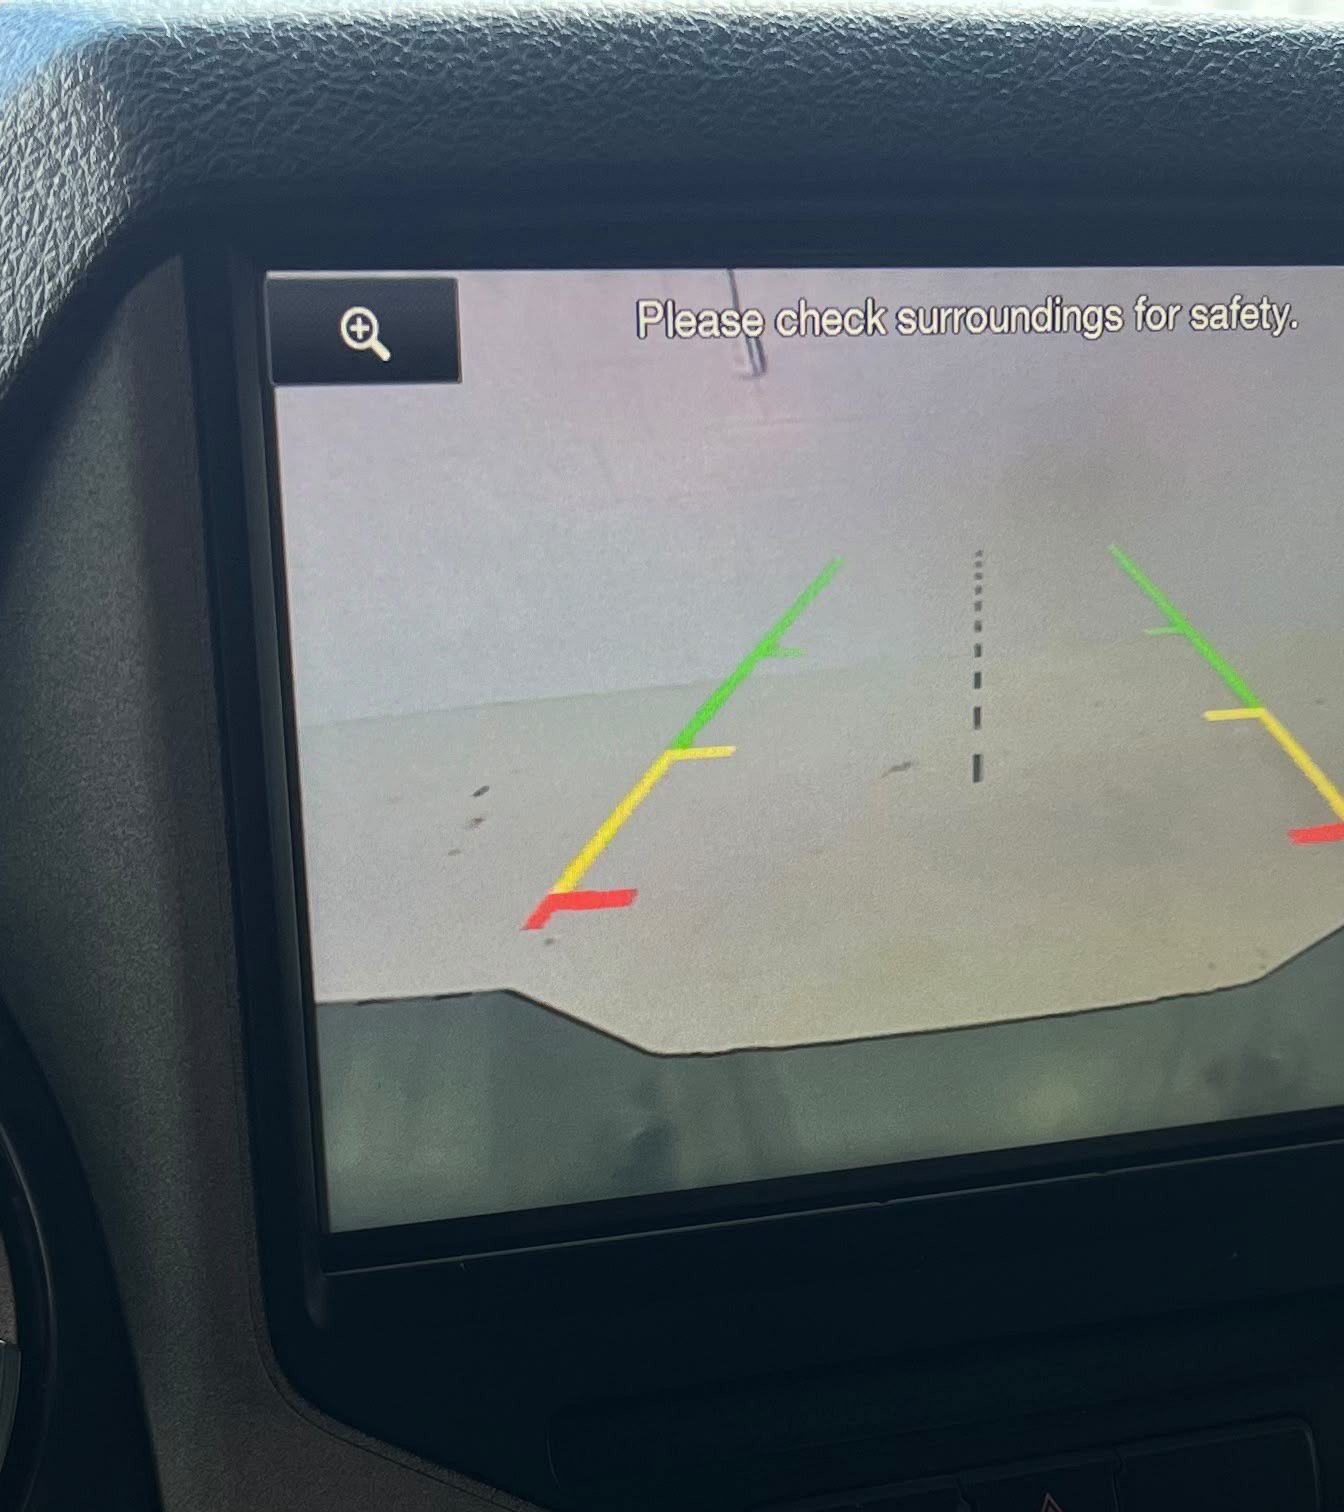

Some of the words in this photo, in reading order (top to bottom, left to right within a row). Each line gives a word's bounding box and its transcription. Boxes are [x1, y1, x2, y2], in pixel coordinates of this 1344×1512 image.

[637, 298, 765, 339] Please
[774, 297, 888, 337] check
[895, 296, 1124, 340] surroundings
[1135, 294, 1181, 332] for
[1189, 294, 1299, 338] safety.
